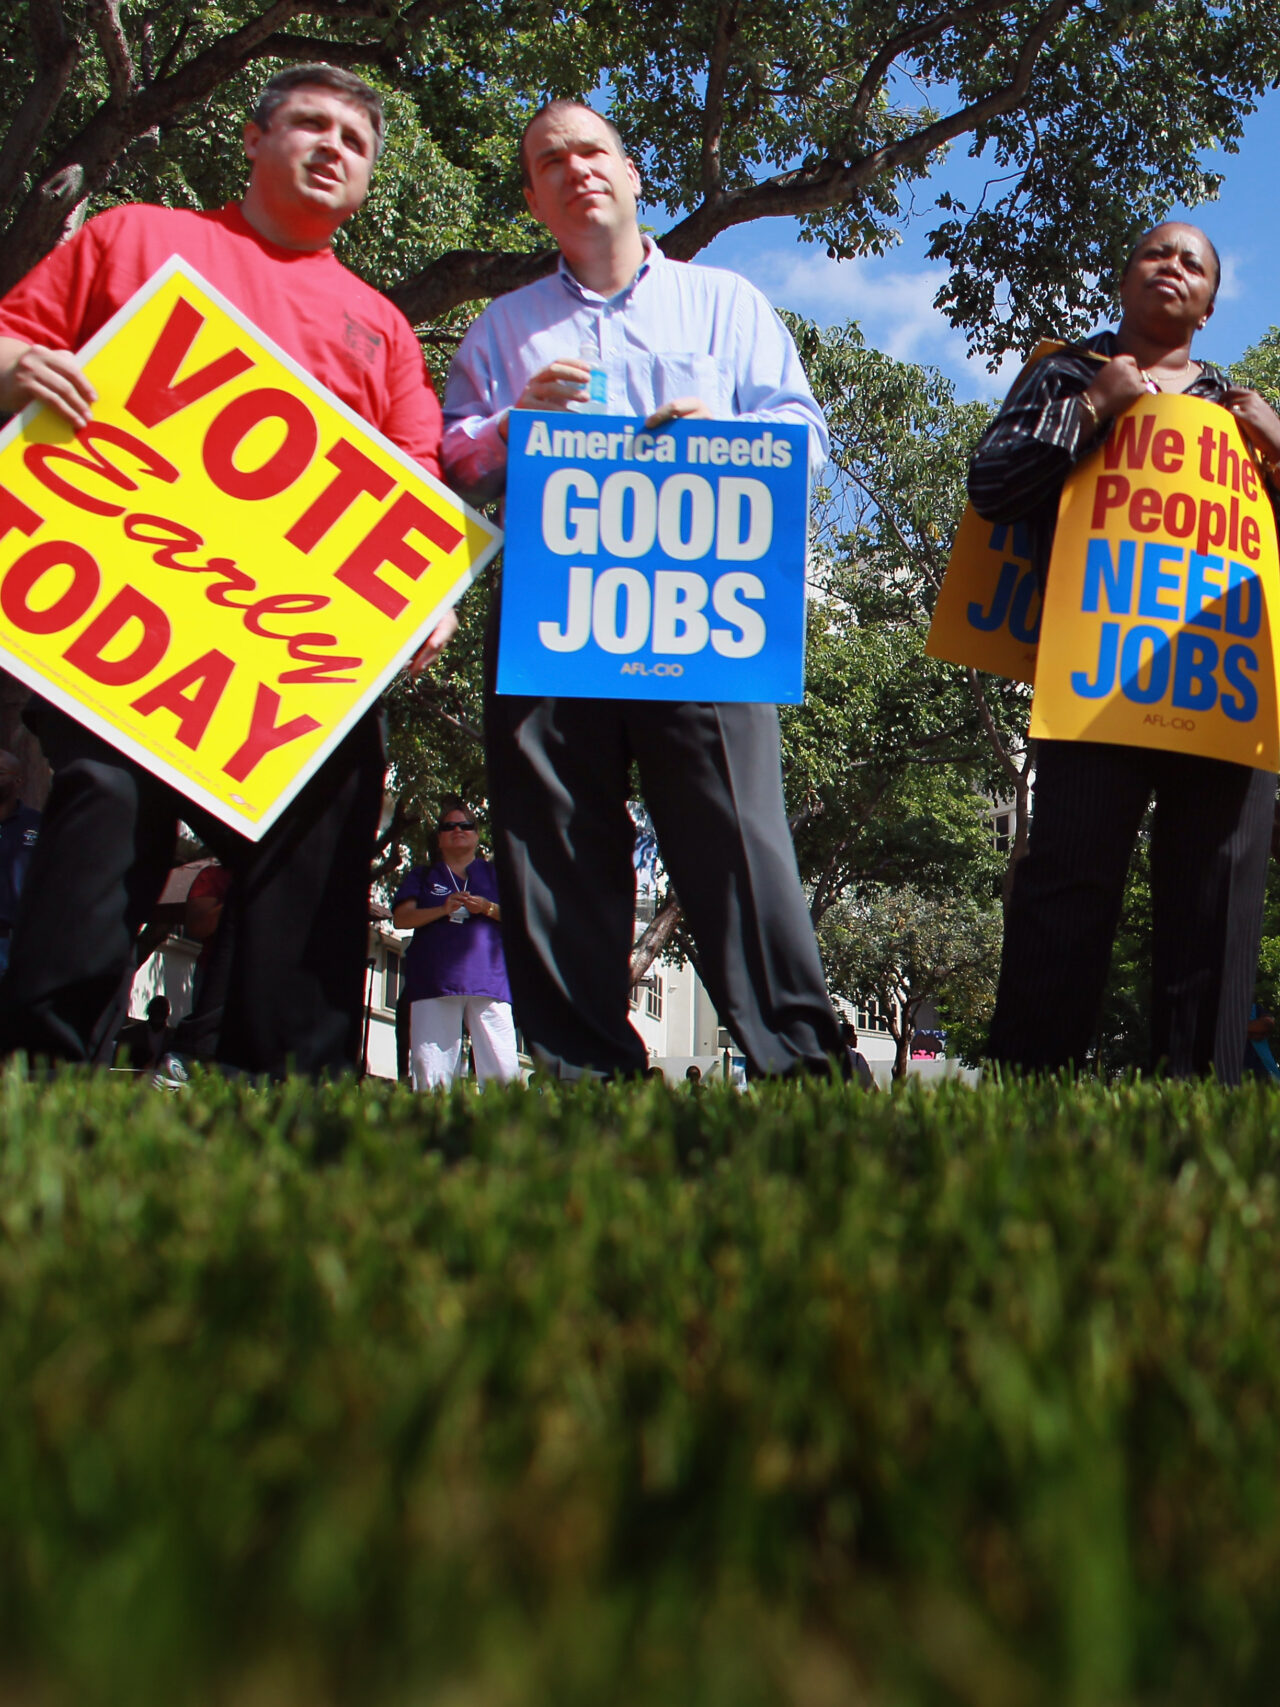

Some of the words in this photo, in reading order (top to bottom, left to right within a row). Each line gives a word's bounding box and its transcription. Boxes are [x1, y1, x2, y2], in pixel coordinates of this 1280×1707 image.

[124, 295, 466, 622] VOTE
[525, 420, 676, 463] America
[687, 431, 793, 468] needs
[1103, 414, 1185, 474] We
[1197, 425, 1258, 502] the
[22, 420, 364, 685] Early
[541, 467, 774, 562] GOOD
[1090, 474, 1261, 561] People
[537, 566, 767, 659] JOBS
[1080, 538, 1262, 640] NEED
[620, 662, 684, 677] AFL-CIO
[1070, 621, 1259, 723] JOBS
[1142, 713, 1196, 733] AFL-CIO
